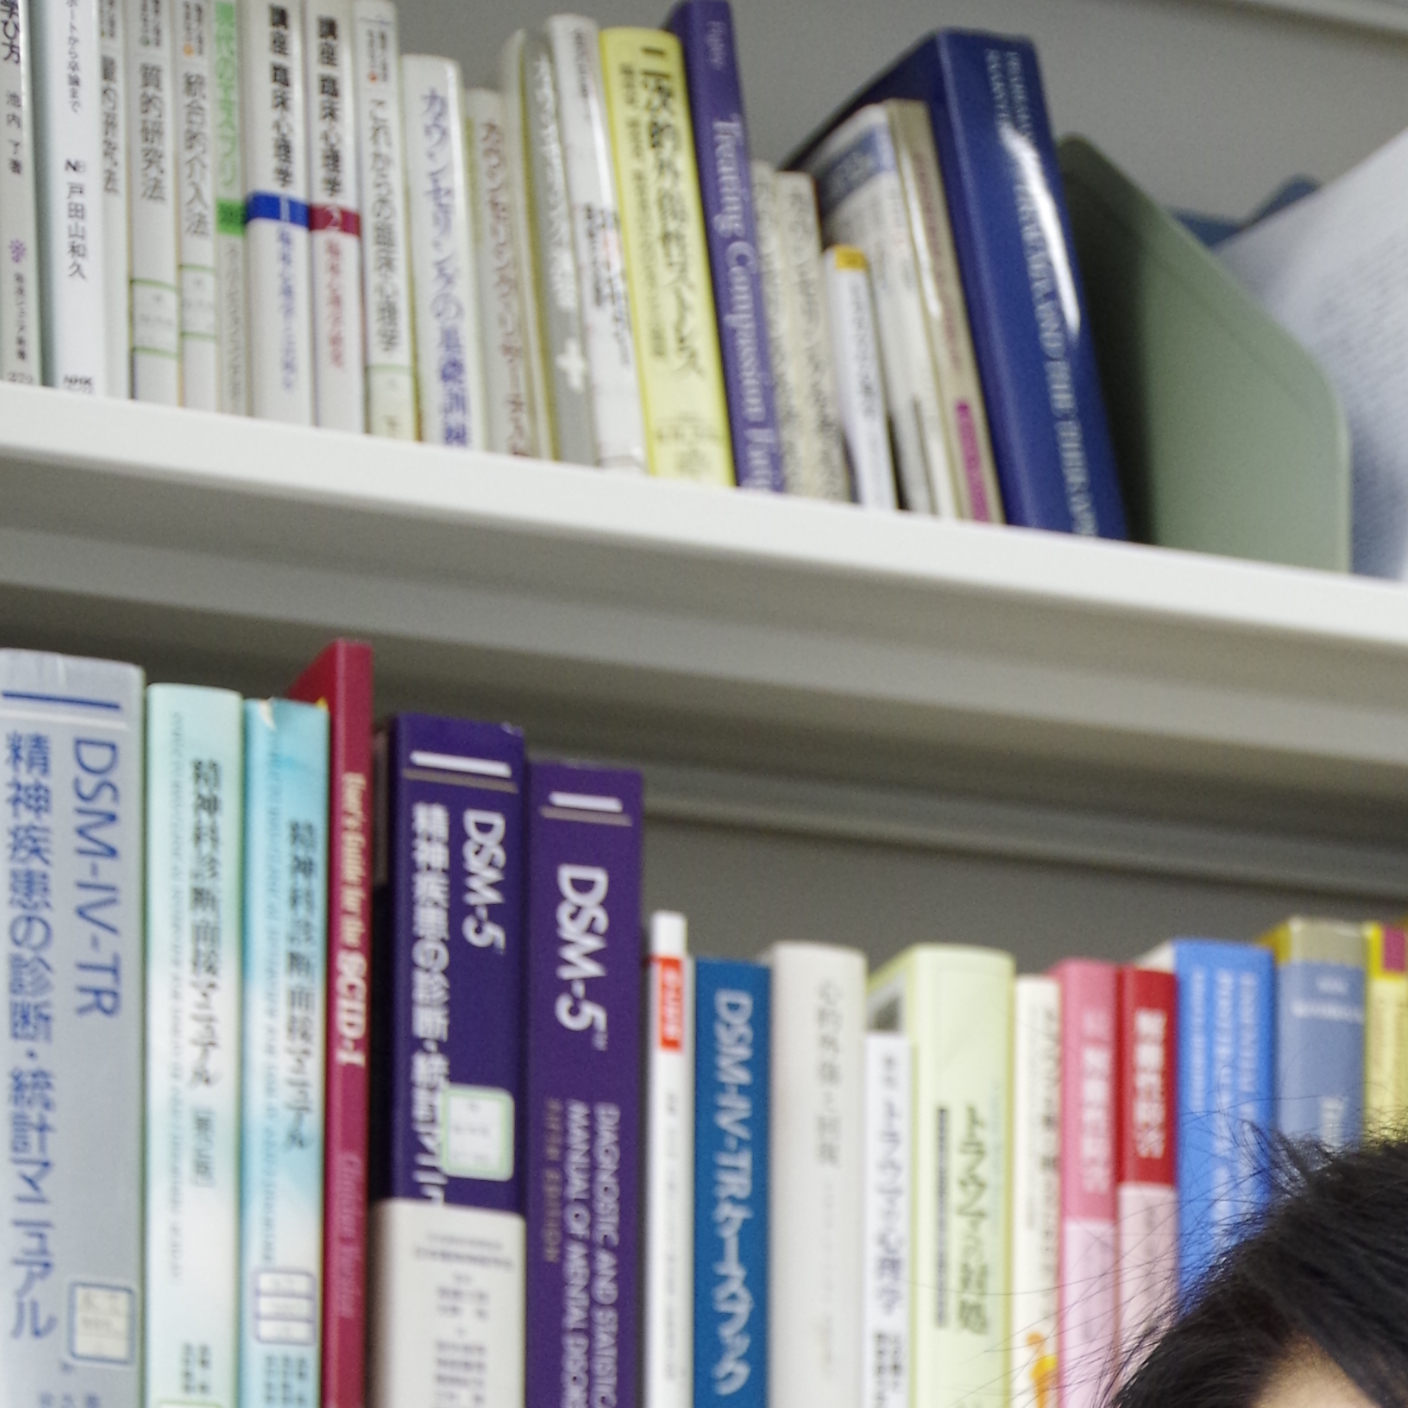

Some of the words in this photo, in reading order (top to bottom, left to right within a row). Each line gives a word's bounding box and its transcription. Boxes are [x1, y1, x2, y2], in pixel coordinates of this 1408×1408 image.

[66, 0, 81, 113] ートから卒論まで
[139, 61, 165, 202] 質的研究法
[182, 70, 209, 238] 統合的介入法
[65, 181, 88, 281] 戸田山和久
[72, 735, 123, 1020] DSM-IV-TR
[462, 808, 507, 955] DSM-5
[335, 949, 367, 1068] SCID-I
[553, 862, 611, 1034] DSM-5
[4, 731, 57, 1342] 精神疾患の診断・統計マニュアル
[565, 1099, 591, 1201] MANUAL
[594, 1101, 622, 1246] DIAGNOSTIC
[563, 1239, 590, 1331] MENTAL
[564, 1202, 590, 1238] OF
[592, 1248, 620, 1306] AND
